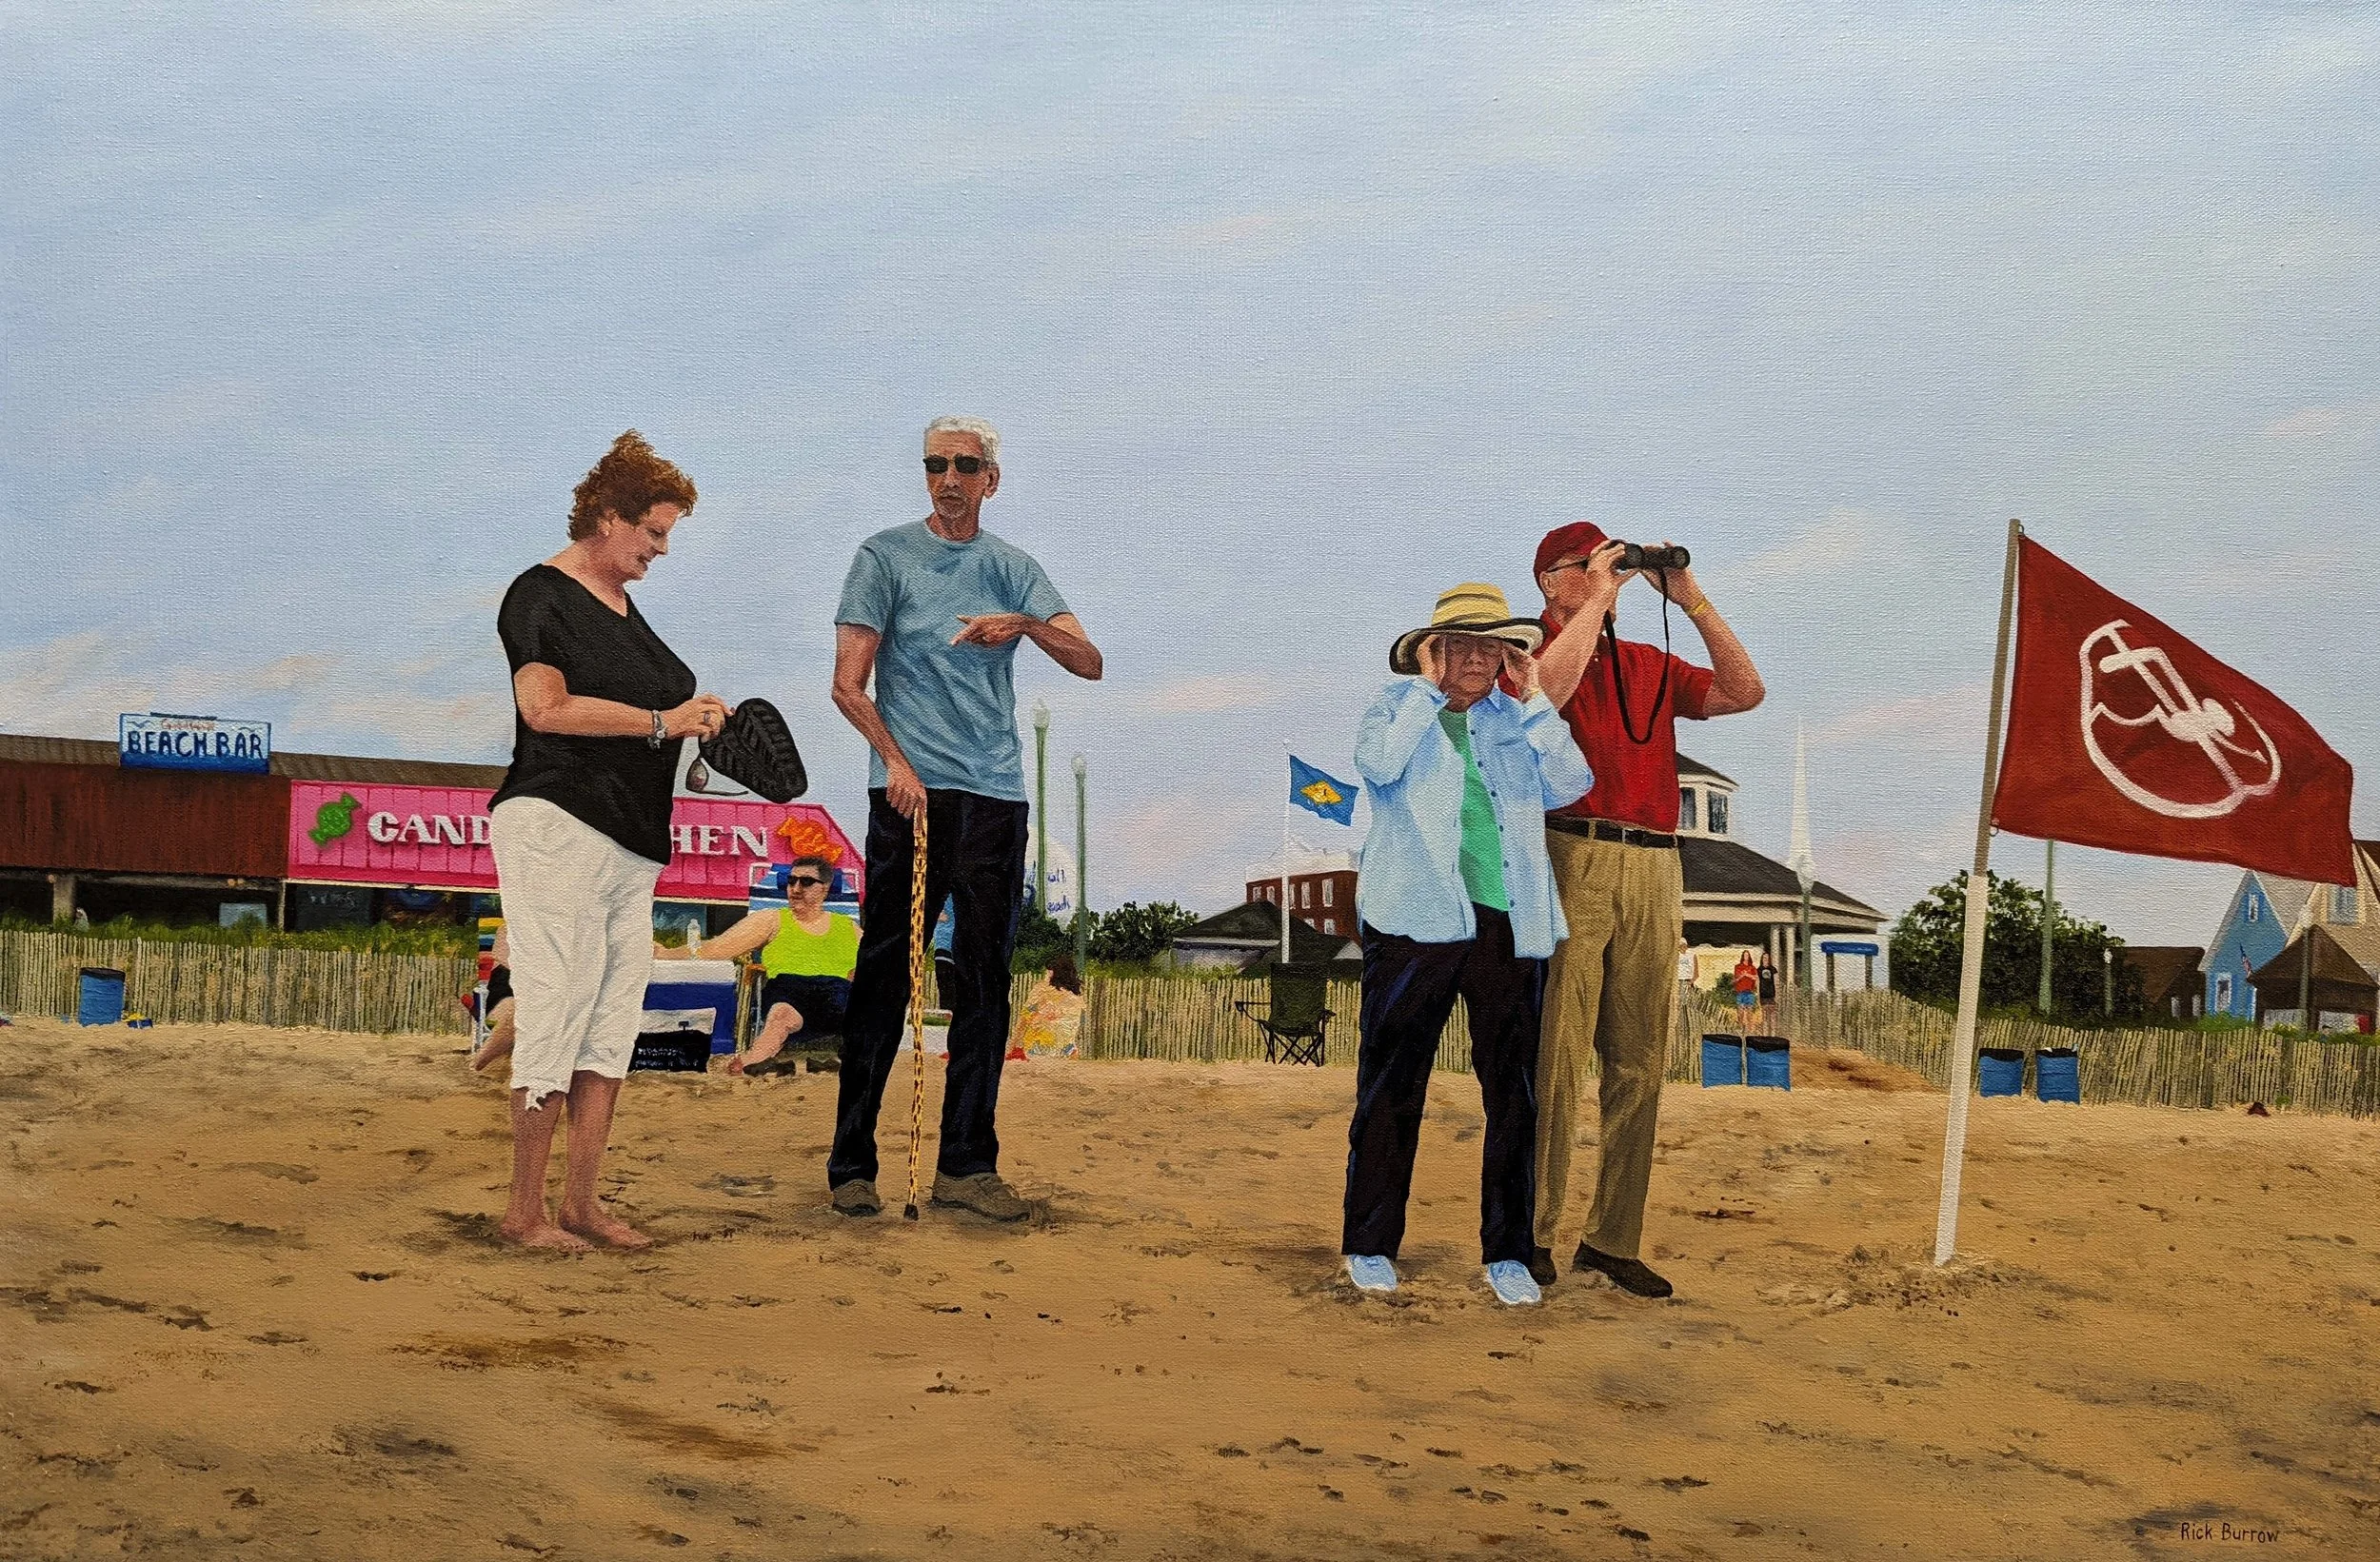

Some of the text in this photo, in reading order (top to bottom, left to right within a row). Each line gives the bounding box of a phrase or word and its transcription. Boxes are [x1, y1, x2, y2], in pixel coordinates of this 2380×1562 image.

[129, 731, 264, 761] BEACH BAR
[2181, 1522, 2280, 1544] Rick Burrow
